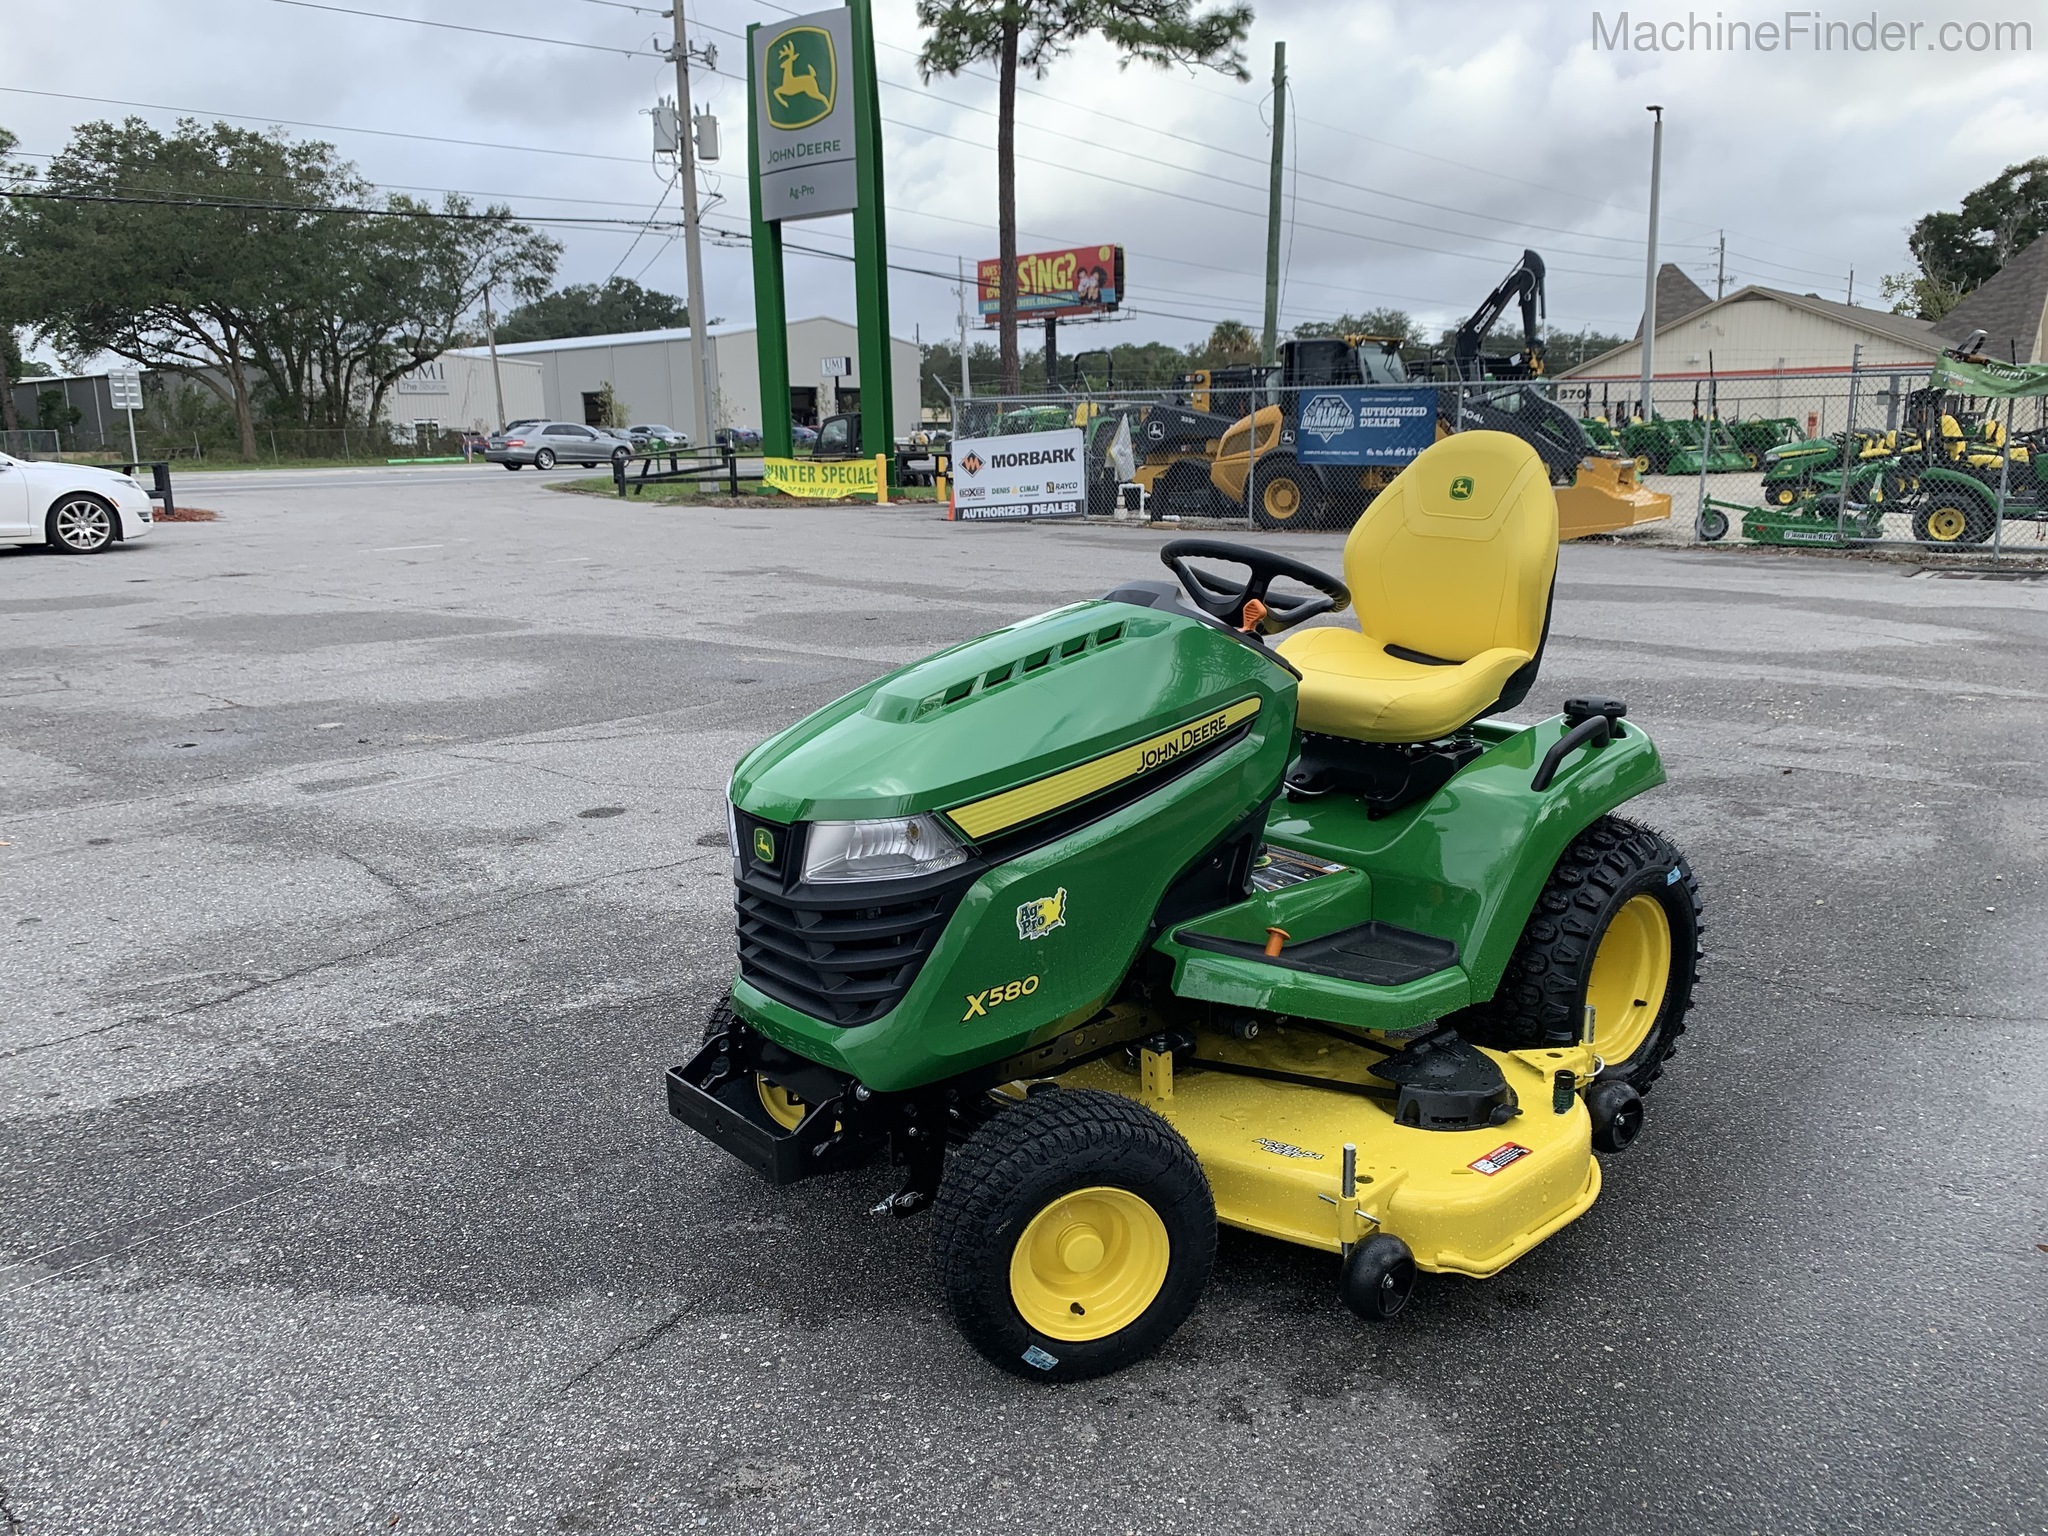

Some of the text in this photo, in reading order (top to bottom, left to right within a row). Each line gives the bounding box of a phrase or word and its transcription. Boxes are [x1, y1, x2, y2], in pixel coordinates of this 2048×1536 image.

[767, 140, 841, 164] JOHN DEERE
[789, 185, 815, 200] Ag-Pro
[1982, 363, 2031, 384] Simply
[1303, 415, 1353, 427] DIAMOND
[1360, 407, 1427, 417] AUTHORIZED
[1360, 418, 1401, 428] DEALER
[991, 447, 1076, 469] MORBARK
[764, 464, 815, 483] WINTER
[1020, 485, 1039, 493] CIMAF
[1056, 482, 1078, 490] RAYCO
[962, 501, 1076, 519] AUTHORIZED DEALER
[1137, 714, 1228, 773] JOHN DEERE
[960, 974, 1040, 1022] X580
